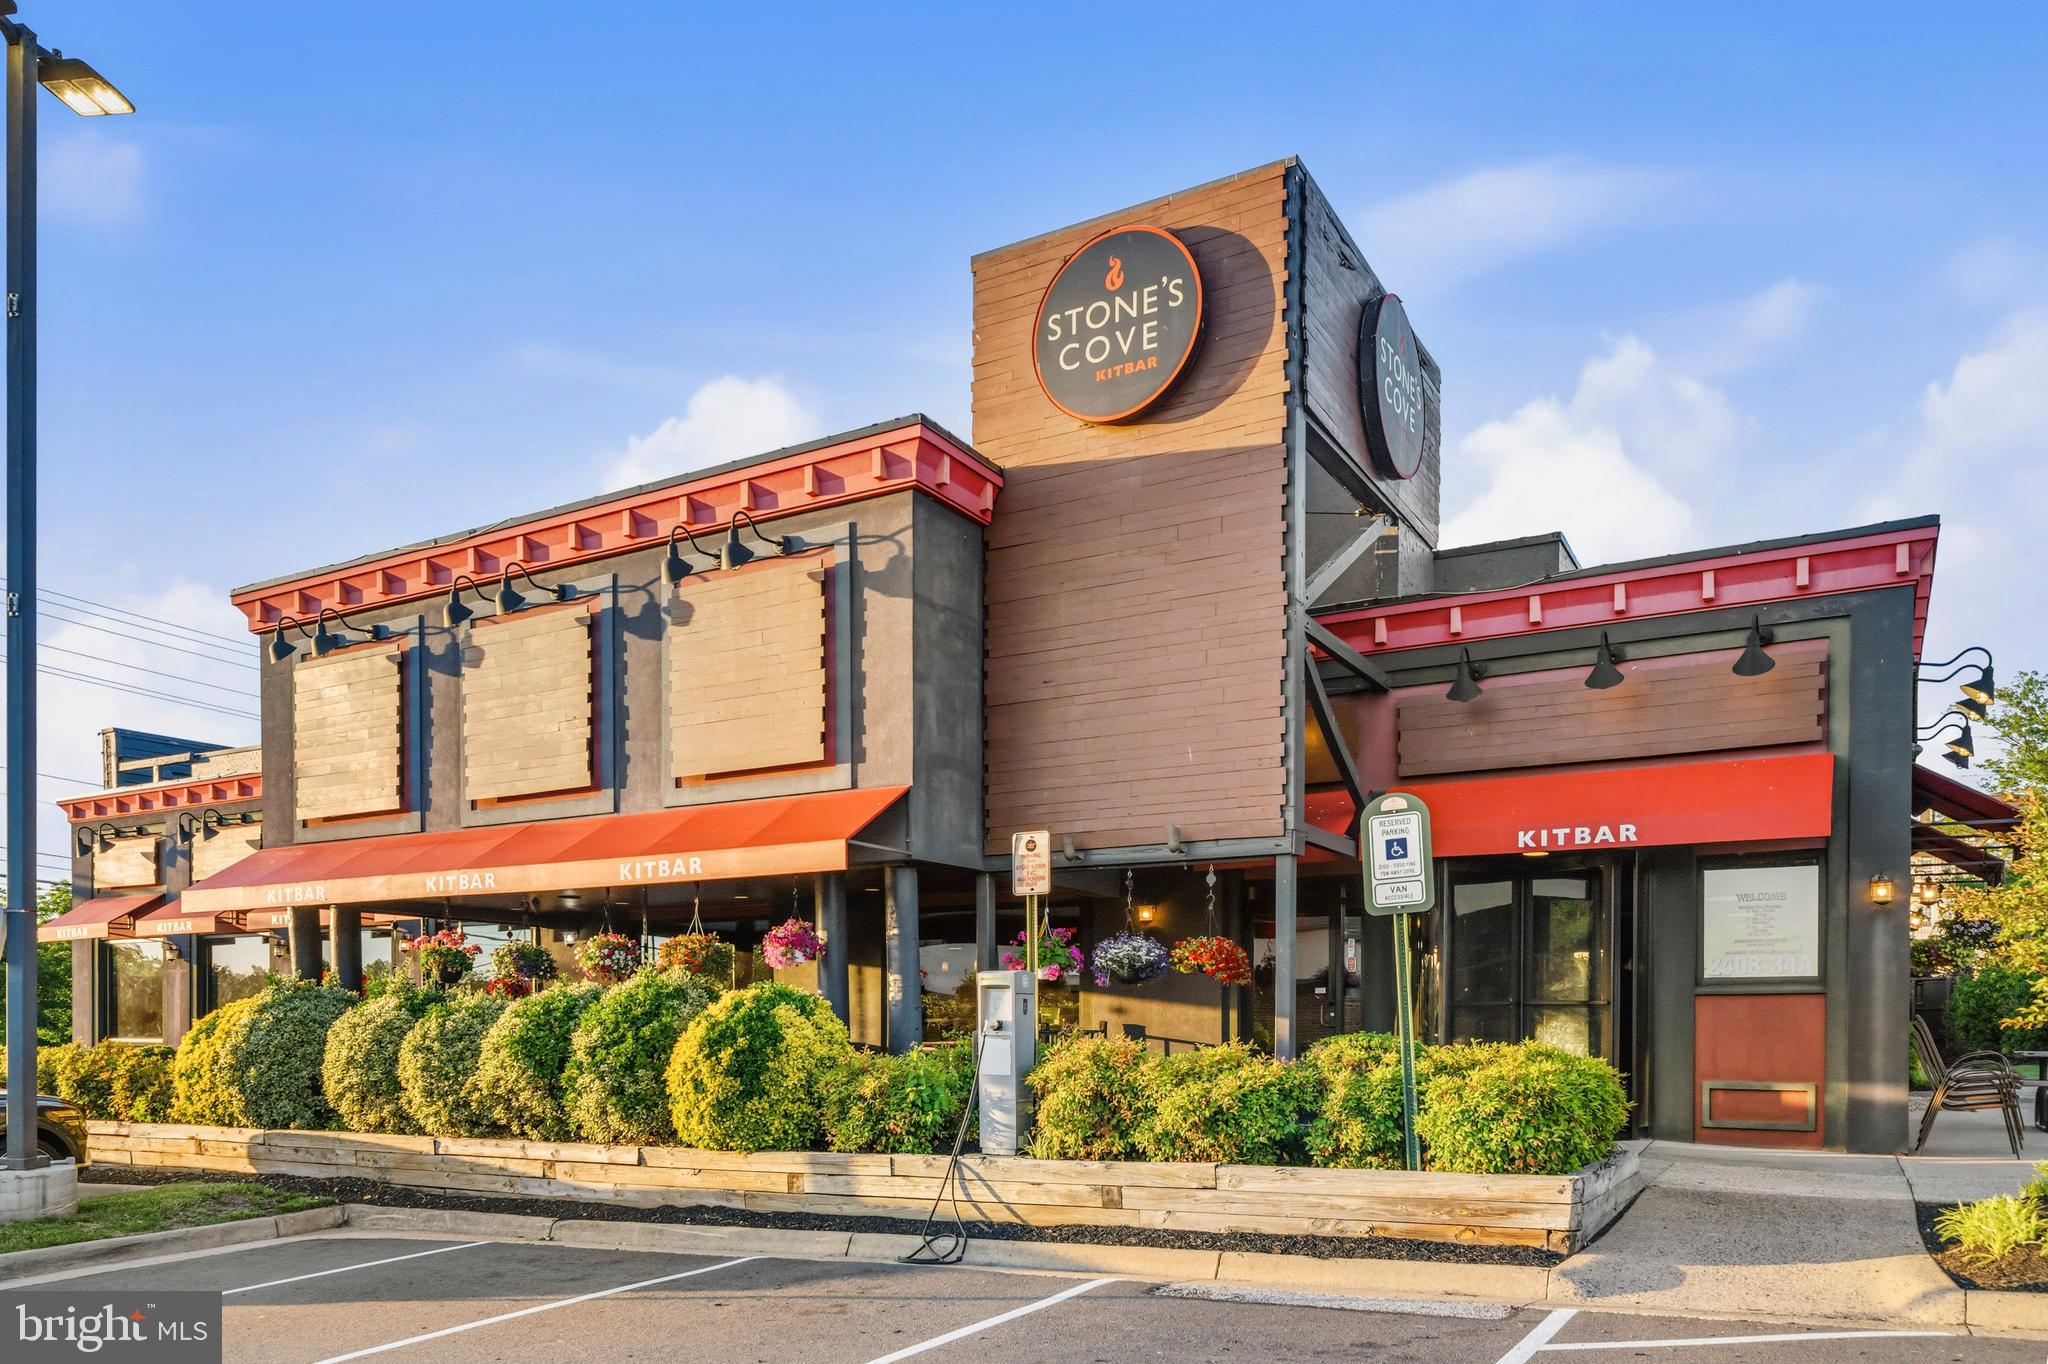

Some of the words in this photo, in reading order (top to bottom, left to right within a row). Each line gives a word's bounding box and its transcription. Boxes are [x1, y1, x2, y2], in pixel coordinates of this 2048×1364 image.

[1047, 276, 1184, 341] STONE'S
[1059, 320, 1159, 371] COVE
[1095, 356, 1159, 382] KITBAR
[1380, 336, 1422, 411] STONE'S
[1384, 376, 1416, 433] COVE
[1378, 817, 1412, 828] RESERVED
[1381, 826, 1410, 837] PARKING
[1518, 823, 1639, 848] KITBAR
[619, 856, 703, 881] KITBAR
[425, 872, 496, 893] KITBAR
[1390, 885, 1408, 893] VAN
[266, 885, 325, 904] KITBAR
[1736, 892, 1787, 902] WELCOME
[156, 920, 193, 933] KITBAR
[271, 913, 291, 926] KIT
[56, 927, 88, 938] KITBAR
